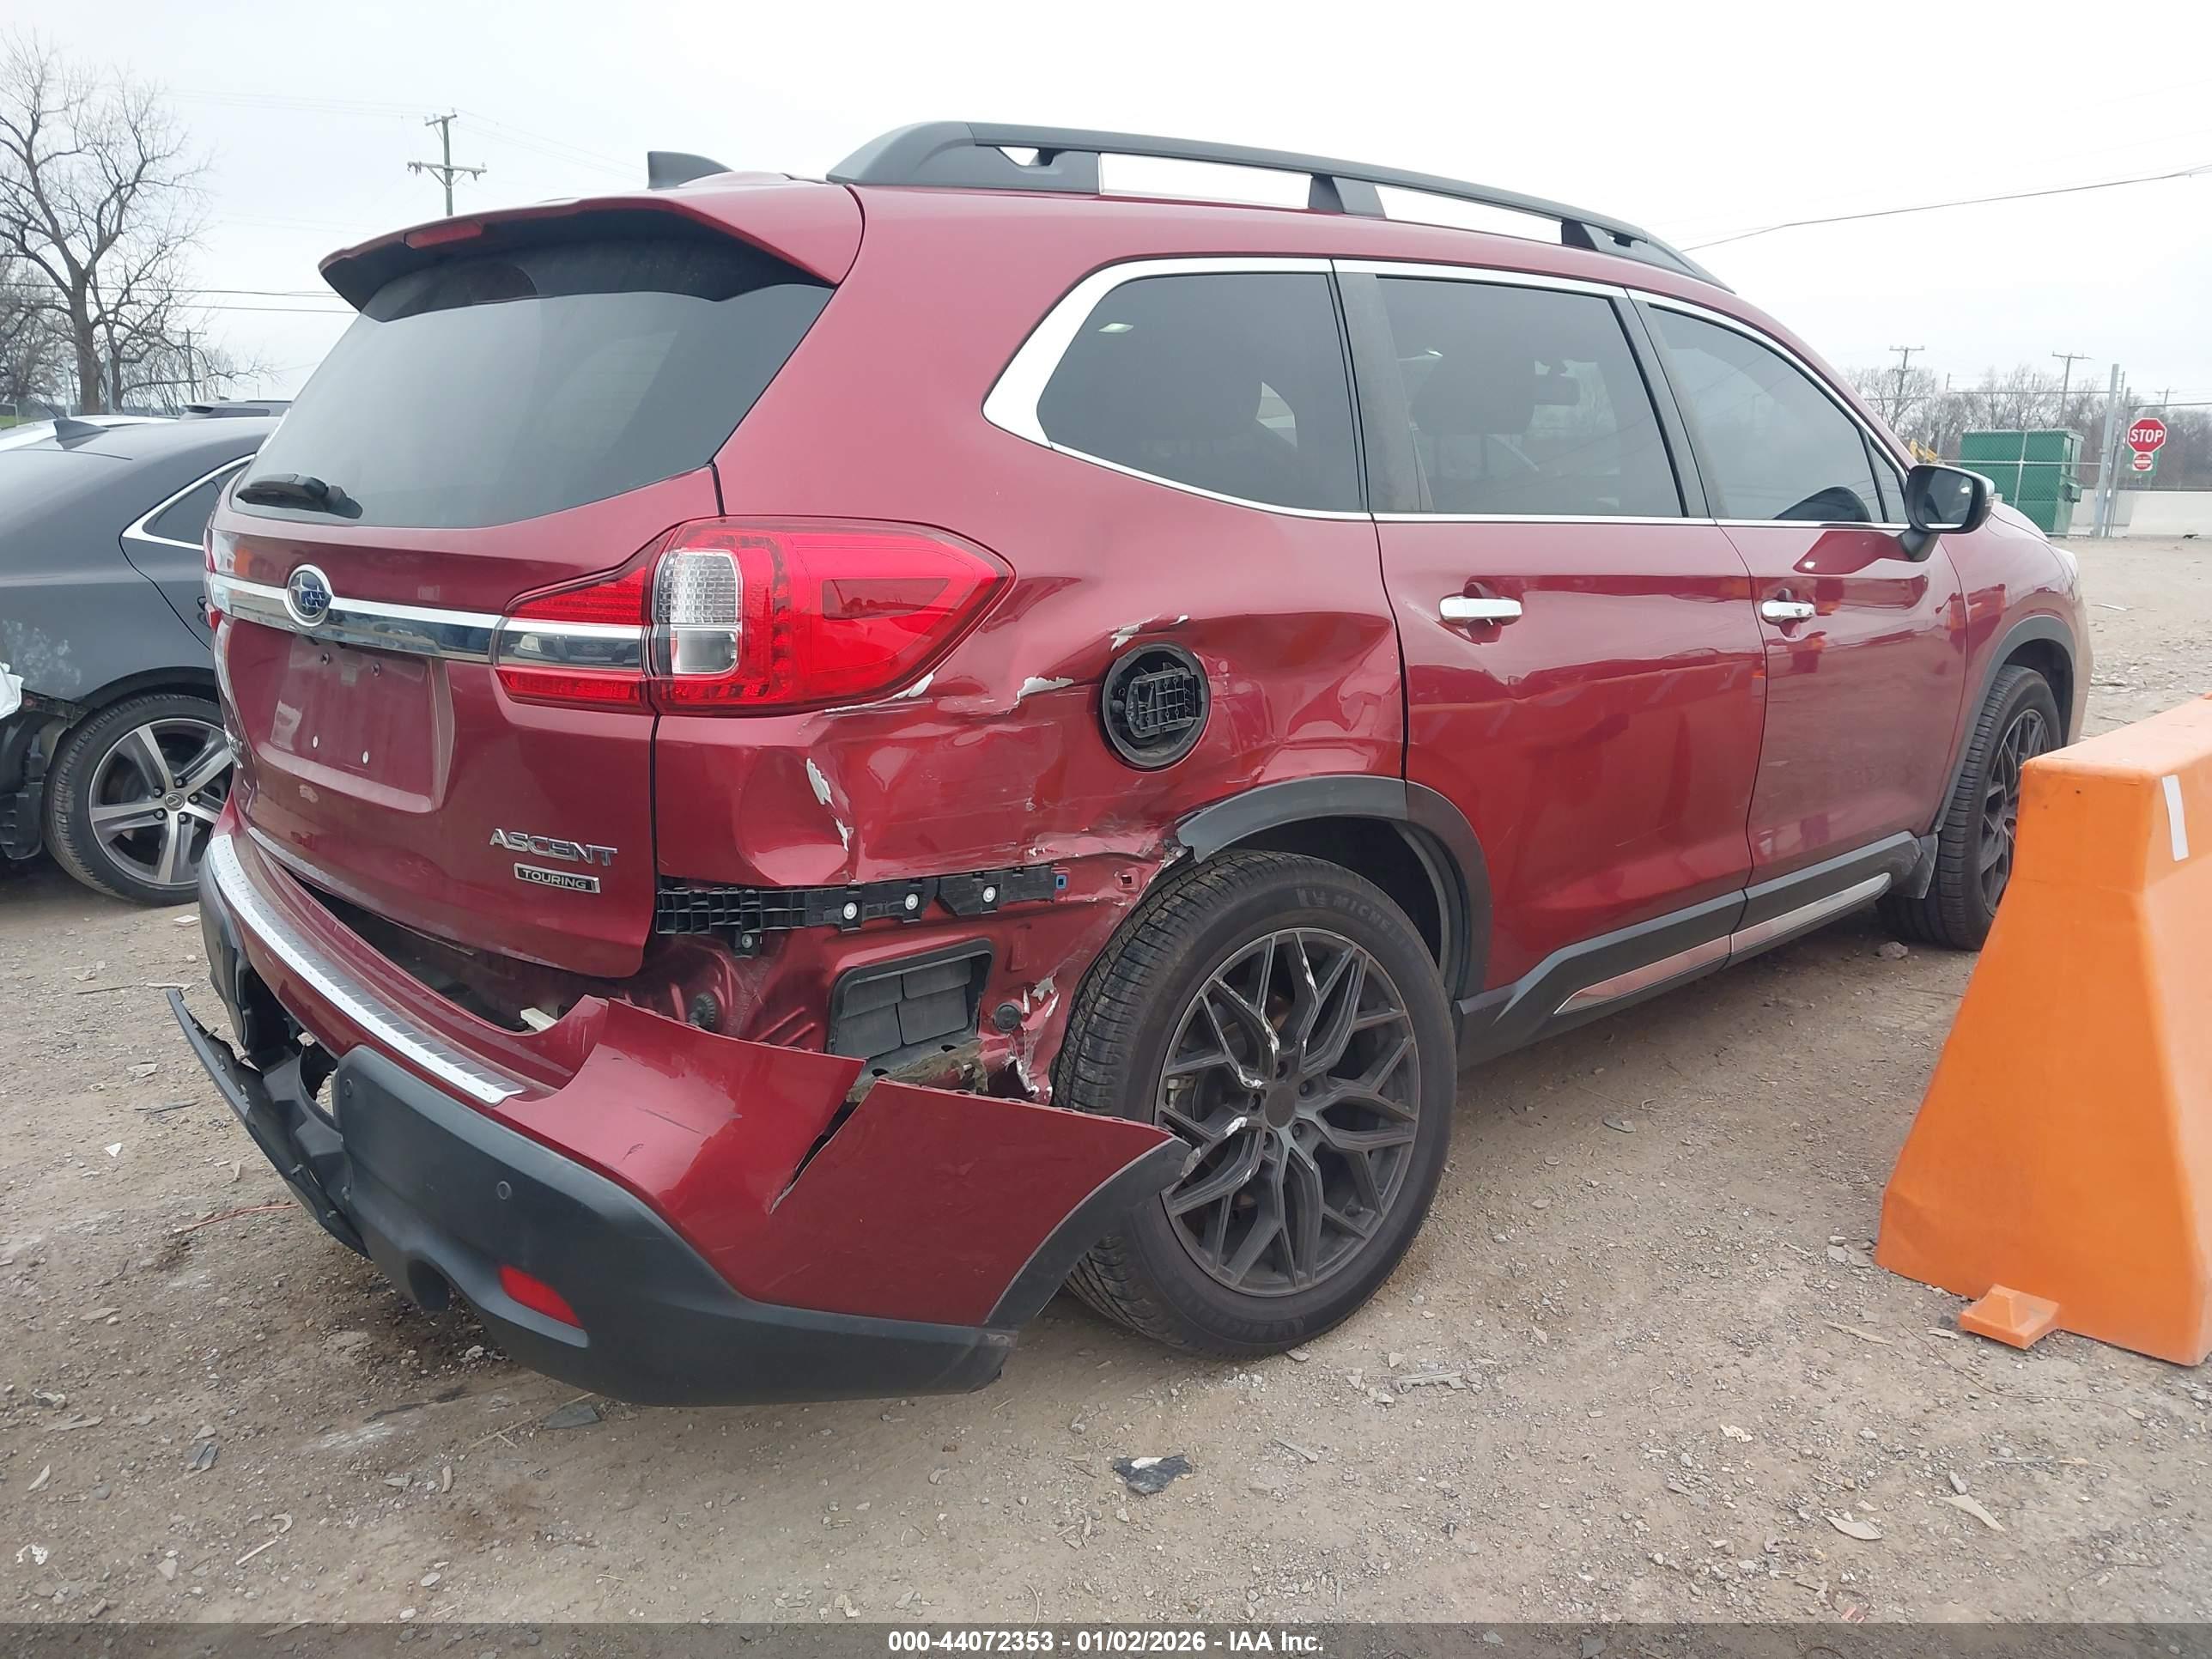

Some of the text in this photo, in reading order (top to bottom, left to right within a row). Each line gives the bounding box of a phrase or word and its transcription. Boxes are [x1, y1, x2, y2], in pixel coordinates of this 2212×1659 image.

[2130, 428, 2164, 443] STOP
[489, 828, 618, 866] ASCENT
[522, 869, 587, 890] TOURING
